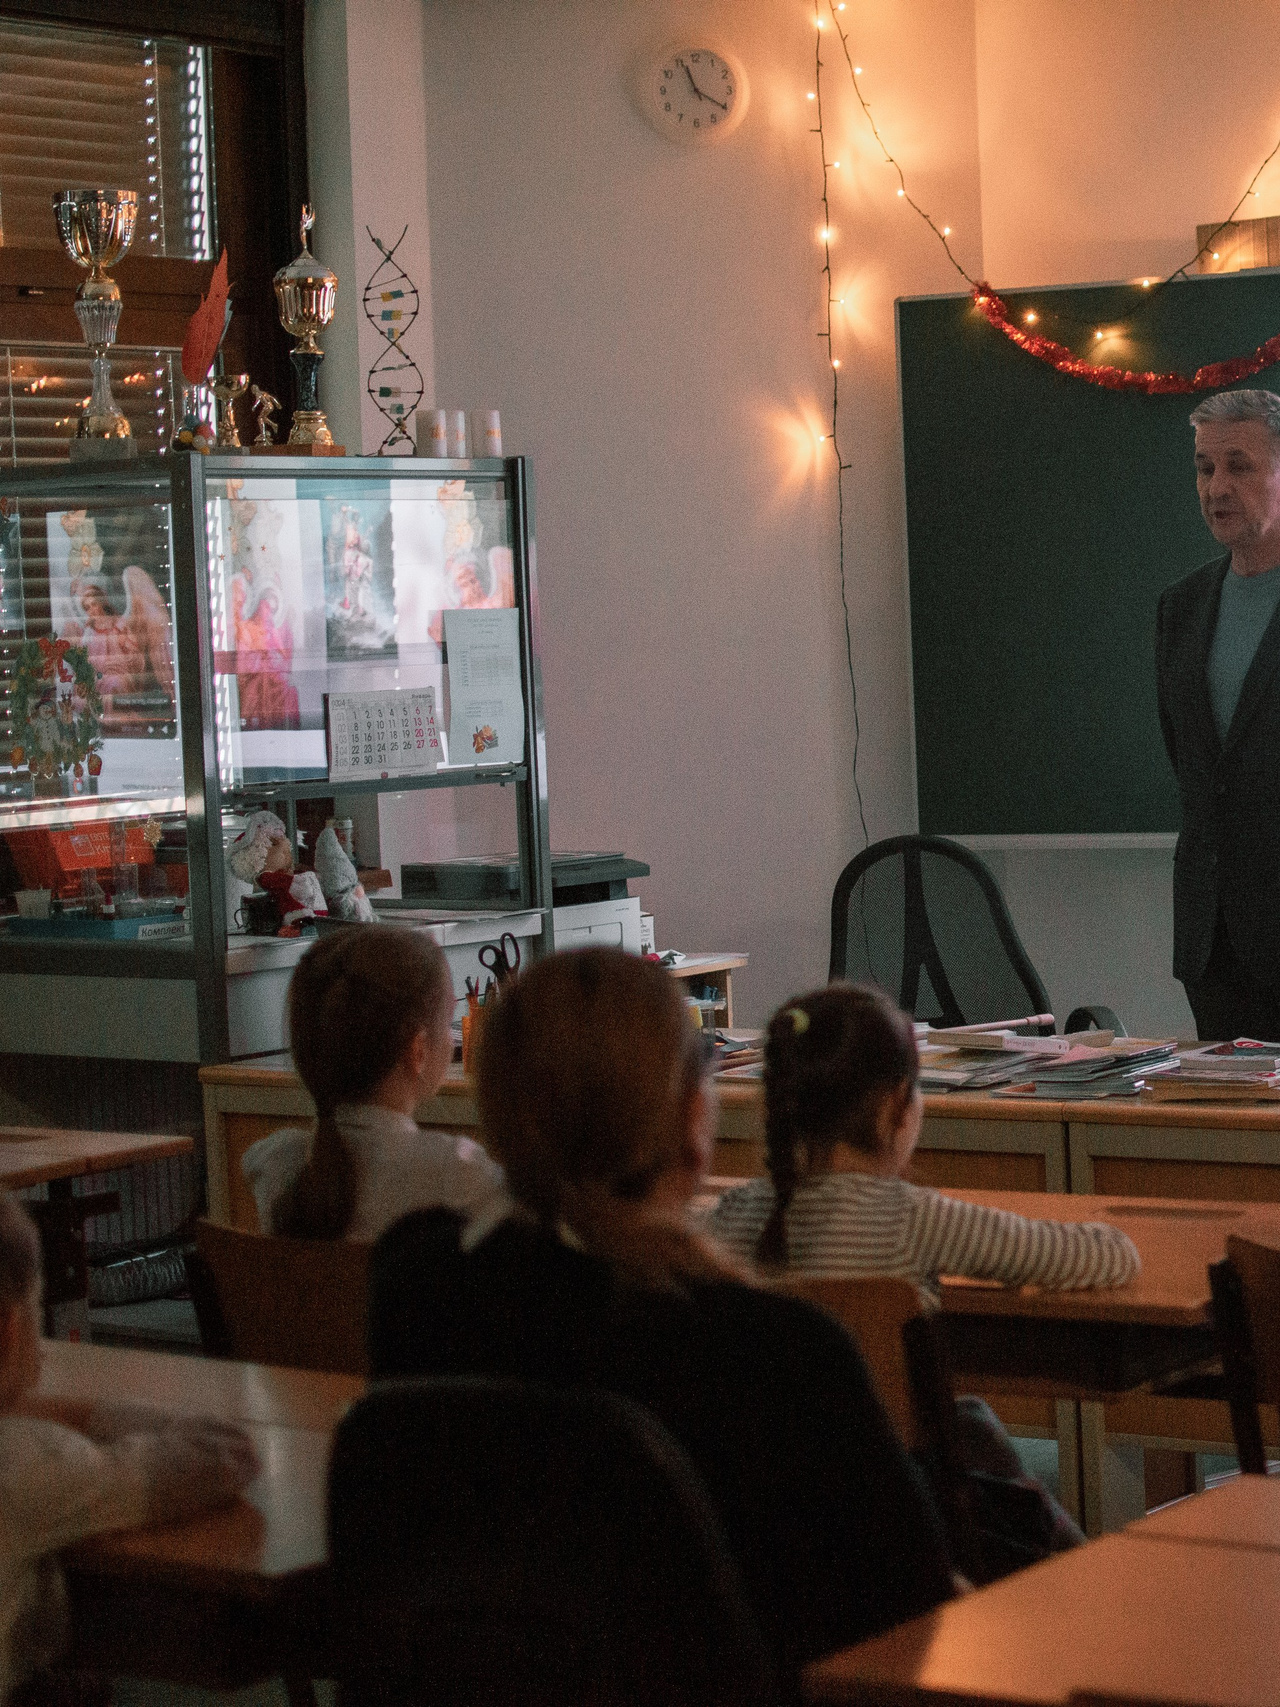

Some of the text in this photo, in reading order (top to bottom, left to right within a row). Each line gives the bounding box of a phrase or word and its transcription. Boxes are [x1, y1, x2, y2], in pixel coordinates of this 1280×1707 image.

[690, 53, 700, 64] 12
[664, 69, 673, 79] 10
[376, 720, 384, 729] 10
[389, 719, 396, 728] 11
[402, 718, 409, 728] 12
[414, 717, 422, 726] 13
[426, 716, 434, 726] 14
[352, 734, 360, 743] 15
[364, 732, 372, 742] 16
[377, 732, 384, 740] 17
[390, 730, 398, 740] 18
[402, 729, 410, 738] 19
[415, 728, 424, 738] 20
[428, 728, 436, 736] 21
[352, 745, 360, 754] 22
[364, 744, 372, 754] 23
[377, 743, 386, 752] 24
[390, 742, 399, 751] 25
[403, 740, 412, 750] 26
[416, 740, 424, 749] 27
[429, 738, 438, 748] 28
[351, 756, 360, 766] 29
[364, 755, 372, 764] 30
[378, 754, 386, 764] 31
[141, 925, 186, 937] Комплект
